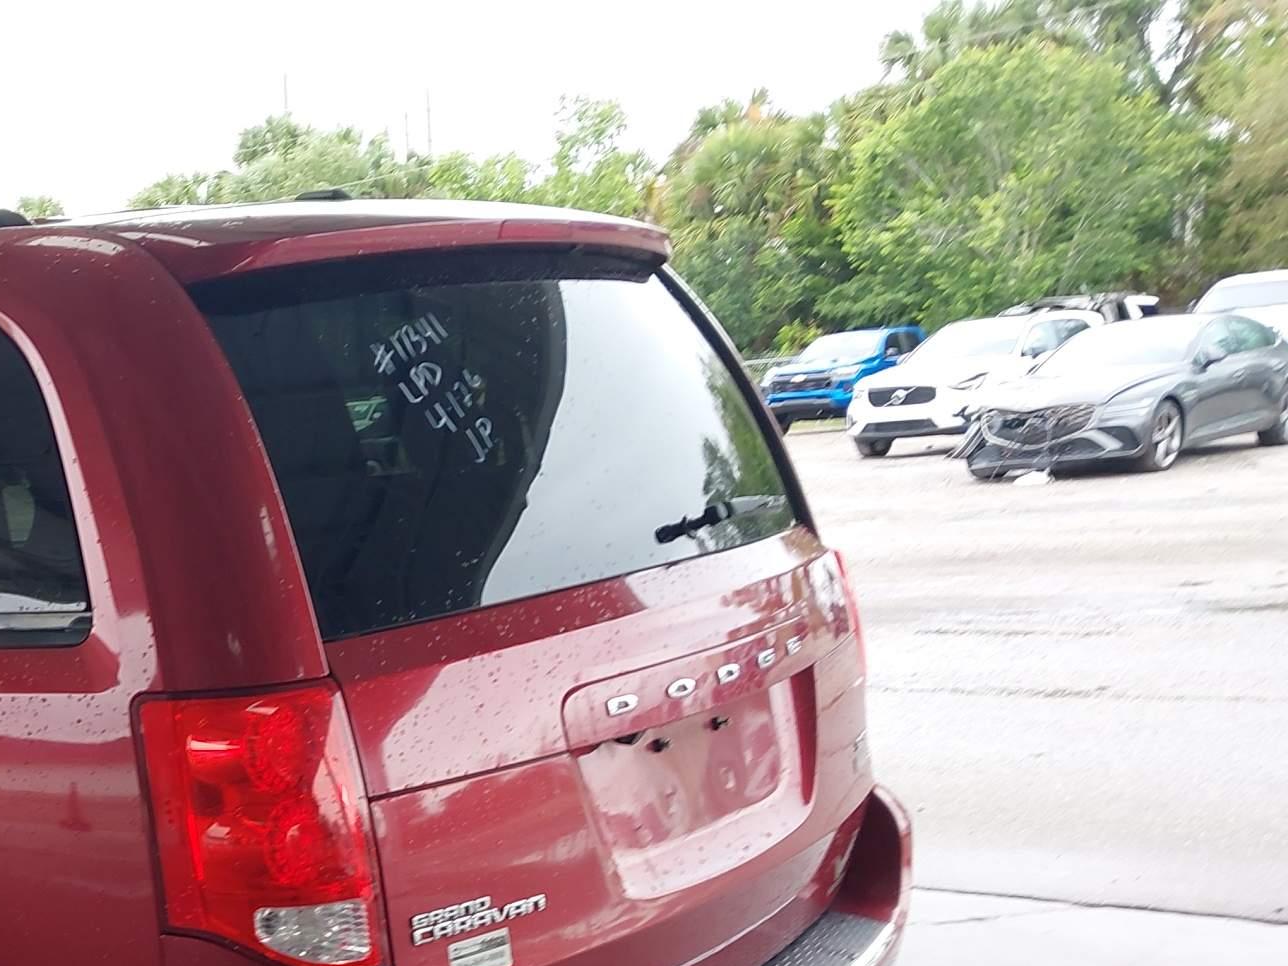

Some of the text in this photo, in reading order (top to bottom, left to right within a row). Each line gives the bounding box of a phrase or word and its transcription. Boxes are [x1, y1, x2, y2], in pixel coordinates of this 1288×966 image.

[605, 635, 803, 717] DODGE
[410, 895, 491, 929] GRAND
[412, 893, 547, 946] CARAVAN
